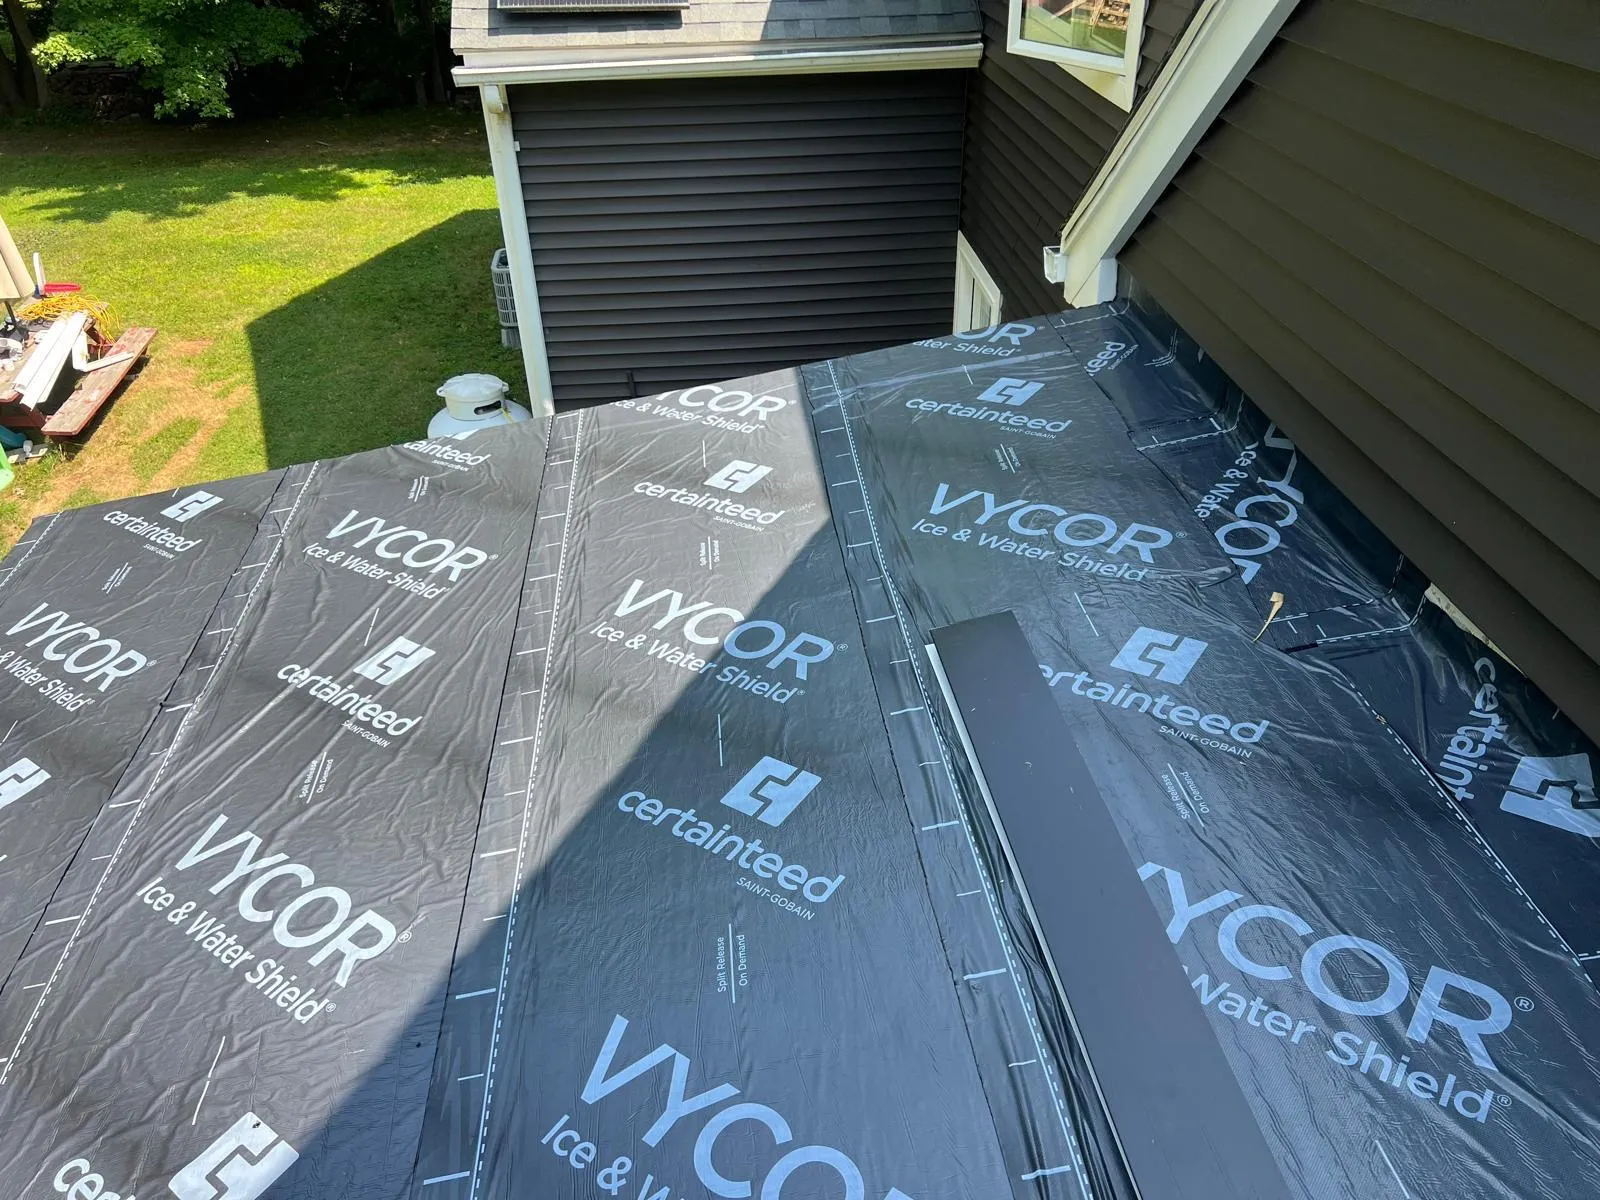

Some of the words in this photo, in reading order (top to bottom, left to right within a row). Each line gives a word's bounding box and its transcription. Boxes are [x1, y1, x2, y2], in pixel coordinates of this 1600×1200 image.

[609, 399, 636, 410] ce
[635, 401, 653, 413] &
[651, 404, 700, 422] Water
[905, 397, 1073, 433] certainteed
[1223, 468, 1249, 479] &
[633, 480, 786, 525] certainteed
[1193, 482, 1241, 521] Wate
[103, 510, 203, 552] certainteed
[712, 514, 765, 532] SAINT-GOBAIN
[911, 518, 949, 536] Ice
[951, 528, 972, 542] &
[978, 532, 1056, 562] Water
[301, 542, 330, 559] Ice
[326, 551, 346, 564] &
[340, 554, 394, 580] Water
[588, 621, 626, 643] Ice
[624, 633, 647, 650] &
[646, 638, 718, 674] Water
[4, 655, 49, 687] Water
[276, 663, 424, 736] certainteed
[341, 719, 393, 749] SAINT-GOBAIN
[1159, 724, 1253, 759] SAINT-GOBAIN
[316, 782, 325, 794] On
[319, 758, 334, 783] Demand
[1161, 773, 1182, 802] Release
[1180, 771, 1204, 802] Demand
[1175, 798, 1191, 820] Split
[1197, 800, 1210, 815] On
[617, 790, 847, 903] certainteed
[736, 876, 816, 921] SAINT-GOBAIN
[135, 877, 176, 912] Ice
[167, 900, 197, 925] &
[184, 910, 255, 969] Water
[716, 935, 726, 971] Release
[736, 934, 747, 971] Demand
[717, 972, 728, 993] Split
[738, 971, 748, 987] On
[581, 1014, 907, 1200] VYCO
[541, 1114, 597, 1169] Ice
[596, 1155, 633, 1196] &
[53, 1158, 136, 1200] ce
